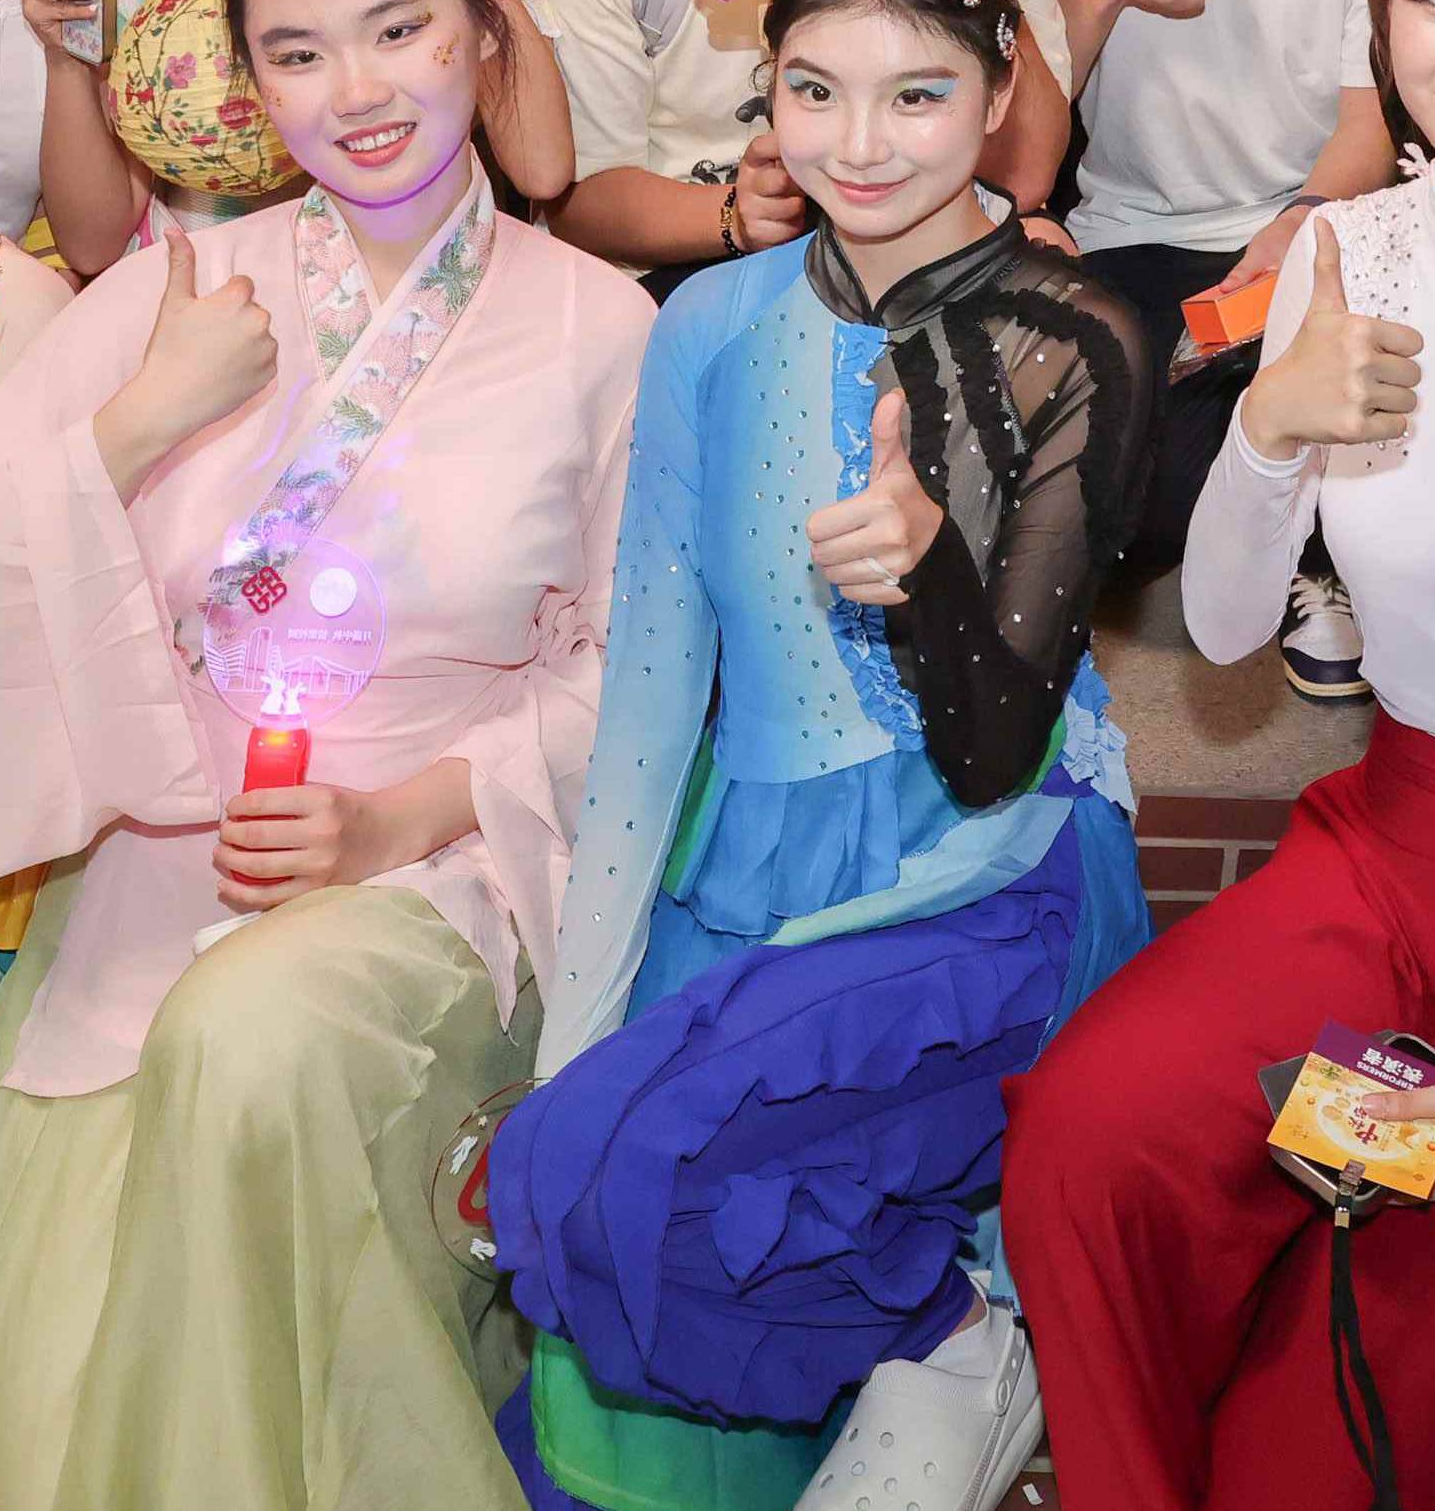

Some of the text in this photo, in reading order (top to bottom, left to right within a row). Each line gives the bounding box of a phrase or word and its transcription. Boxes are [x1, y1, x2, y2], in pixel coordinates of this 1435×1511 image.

[1356, 1061, 1415, 1091] ERFORMERS
[1361, 1047, 1425, 1084] 表演者
